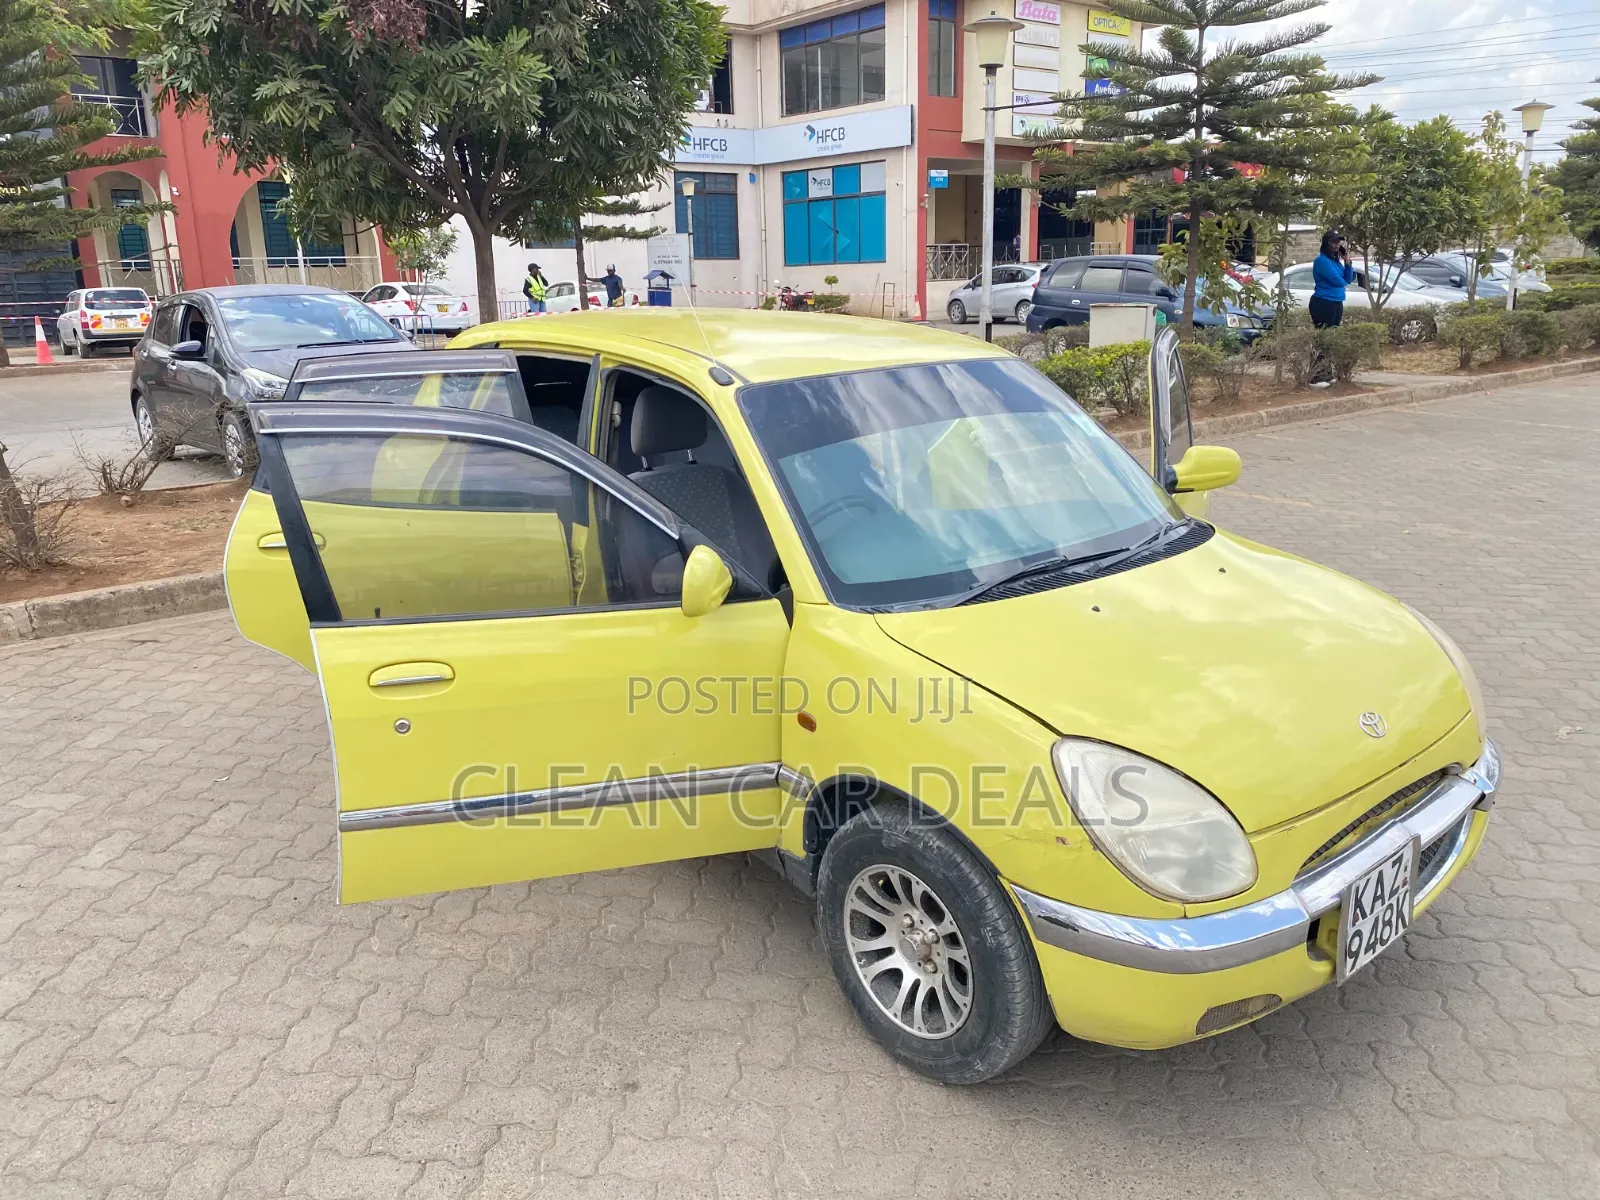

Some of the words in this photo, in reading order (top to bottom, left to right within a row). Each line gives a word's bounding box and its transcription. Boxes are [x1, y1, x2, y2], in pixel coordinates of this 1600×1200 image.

[1019, 0, 1057, 21] Bata
[1093, 16, 1117, 29] OPTICA
[1094, 83, 1121, 96] Avenue
[692, 136, 728, 152] HFCB
[816, 127, 846, 144] HFCB
[1352, 853, 1404, 921] KAZ
[1347, 890, 1409, 973] 948K
